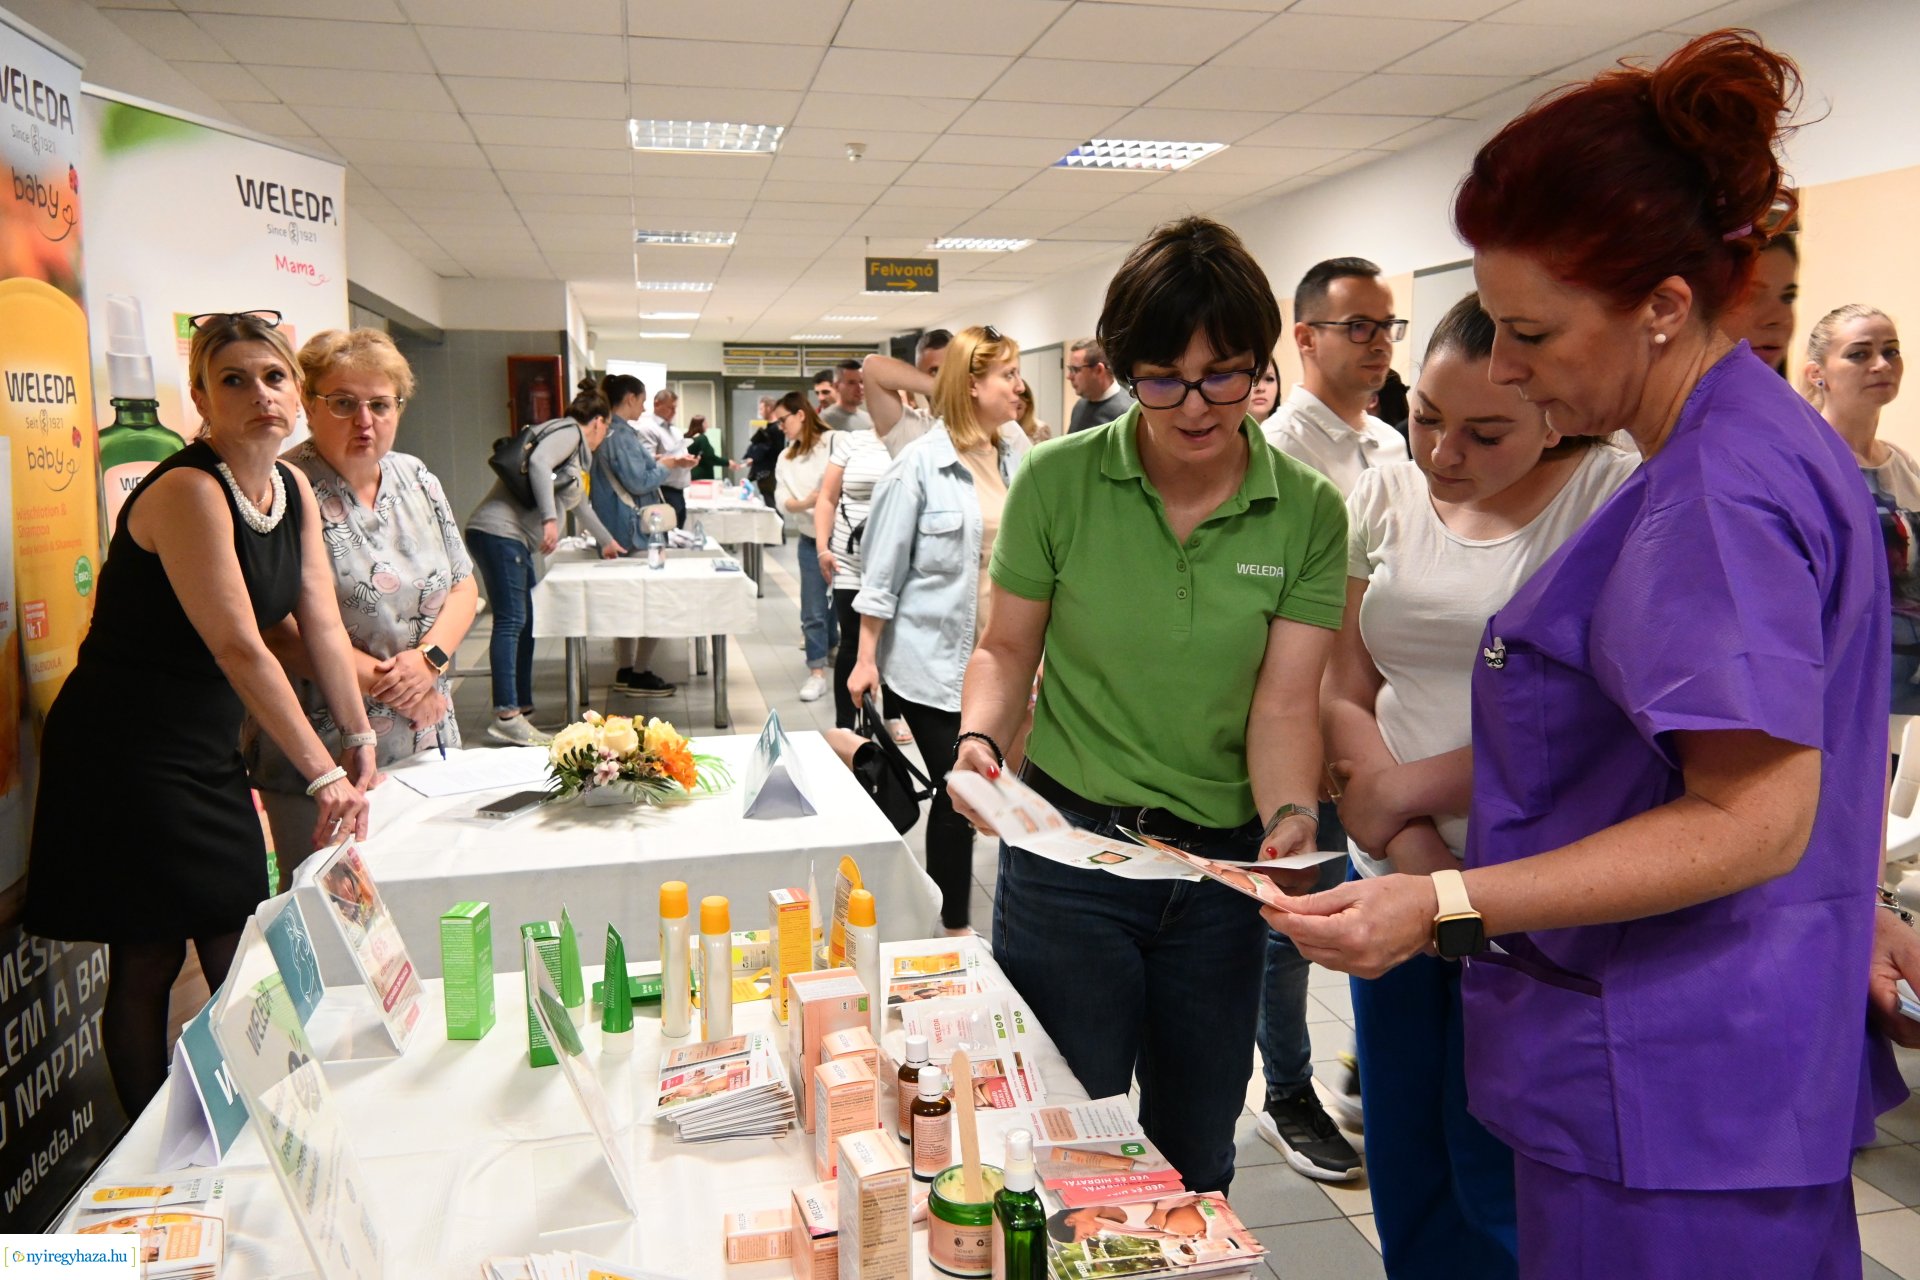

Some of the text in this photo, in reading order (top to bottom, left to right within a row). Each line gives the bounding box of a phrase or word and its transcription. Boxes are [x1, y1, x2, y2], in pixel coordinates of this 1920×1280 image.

[11, 123, 57, 154] Since 1921
[11, 166, 59, 218] baby
[235, 174, 338, 227] WELEDA
[266, 223, 317, 243] Since 1921
[275, 254, 315, 276] Mama
[869, 261, 934, 277] Felvonó
[5, 370, 78, 404] WELEDA
[25, 417, 64, 430] Seit 1921
[26, 445, 64, 474] baby
[1236, 562, 1284, 578] WELEDA
[54, 978, 71, 1027] A
[933, 1017, 943, 1044] WELEDA
[14, 1006, 104, 1127] NAPJÁT
[5, 1100, 94, 1214] weleda.hu
[1065, 1174, 1150, 1187] VÉD ÉS HIDRATÁL
[806, 1197, 824, 1222] WELEDA
